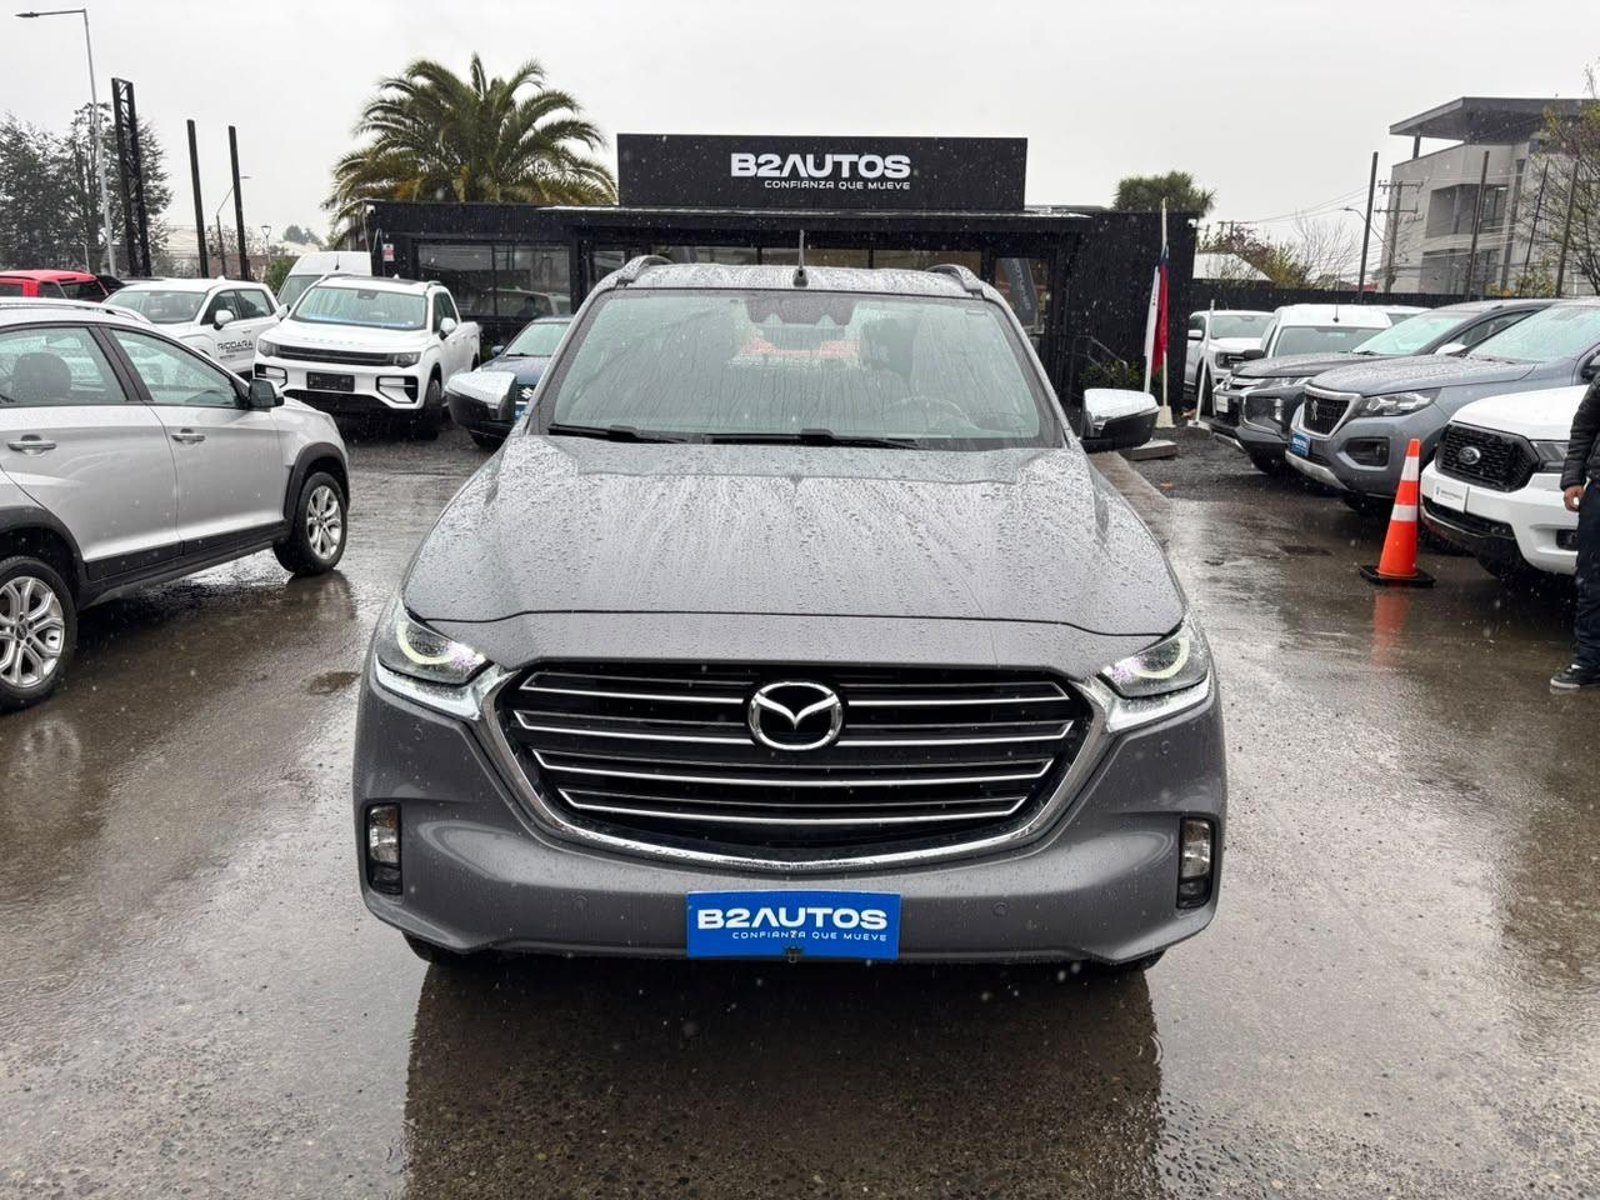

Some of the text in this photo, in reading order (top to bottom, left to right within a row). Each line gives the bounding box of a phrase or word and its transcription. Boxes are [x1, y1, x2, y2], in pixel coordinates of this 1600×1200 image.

[731, 153, 911, 179] B2AUTOS
[764, 180, 911, 190] CONFIANZA QUE MUEVE
[697, 907, 888, 930] B2AUTOS
[732, 930, 888, 942] CONFIANZA QUE MUEVE
